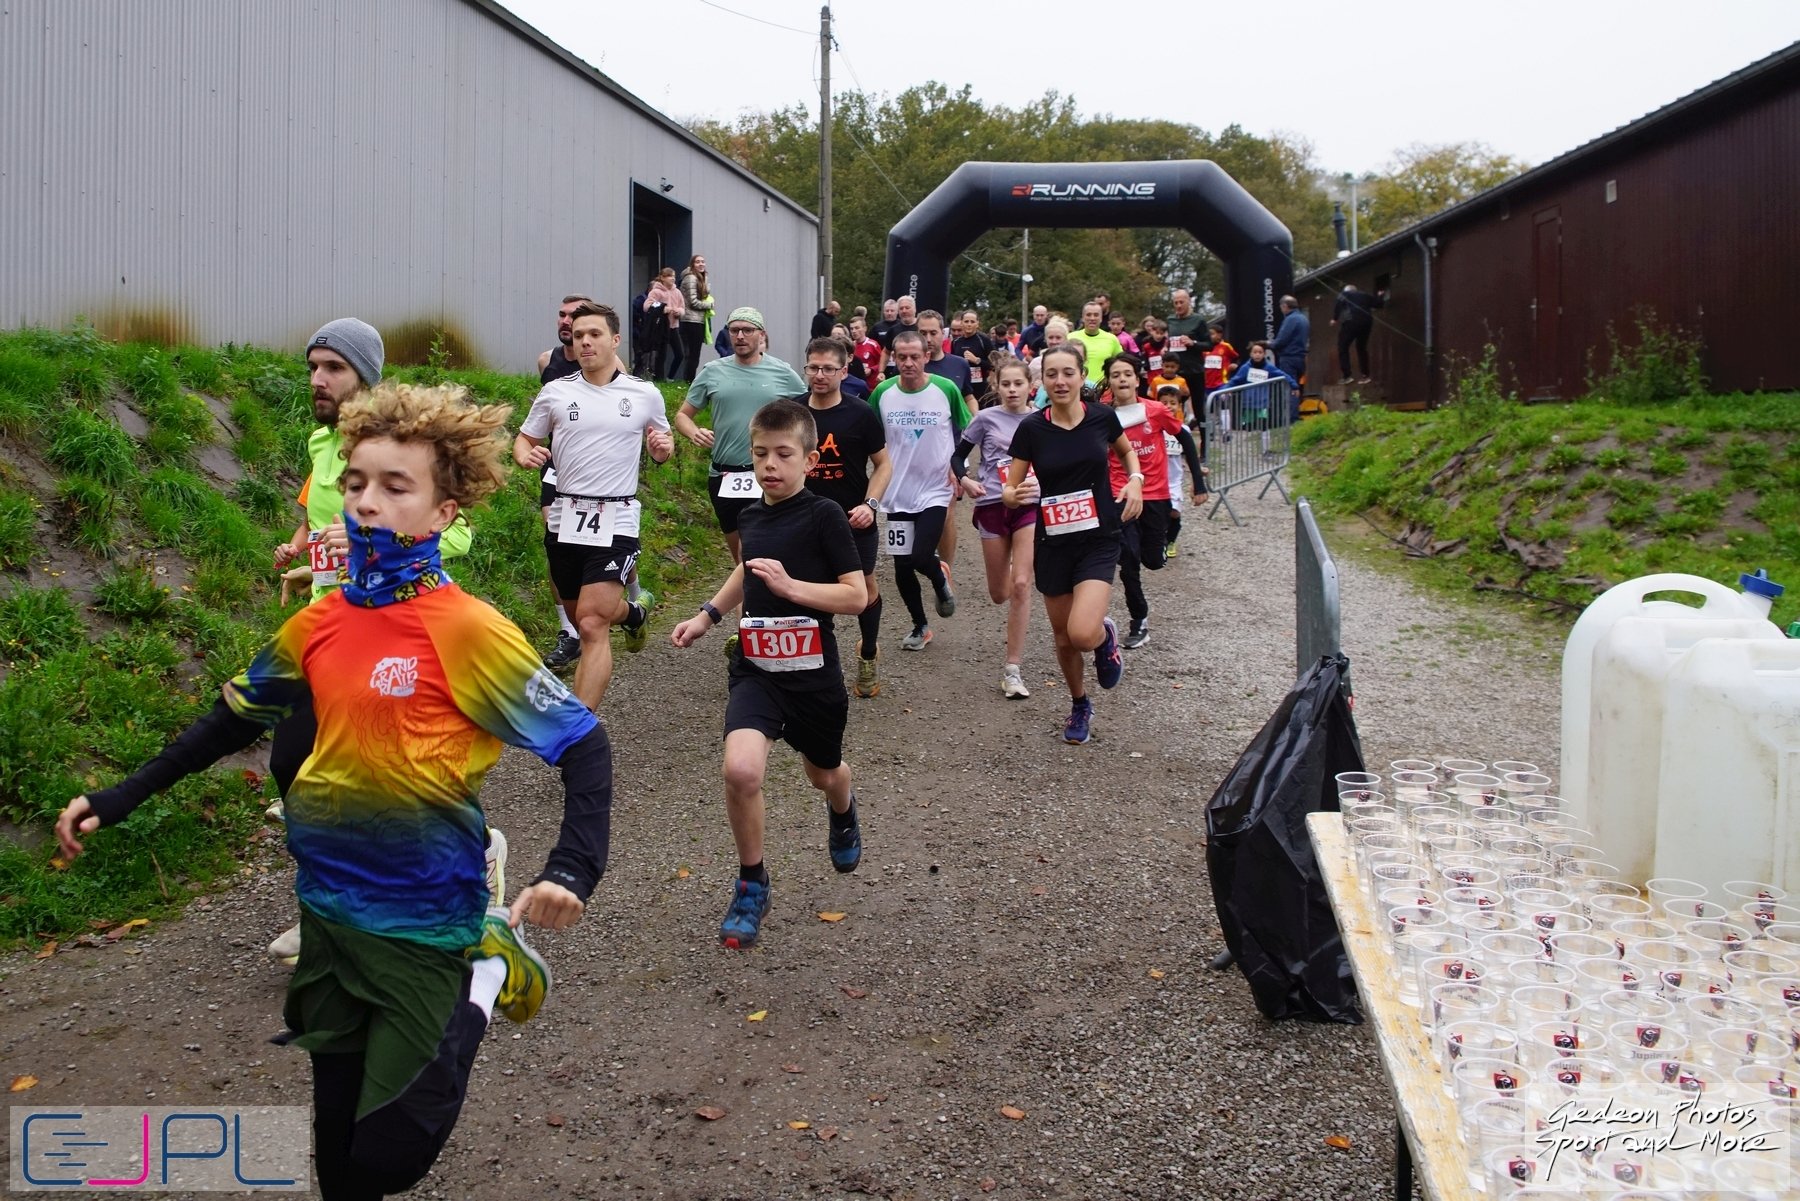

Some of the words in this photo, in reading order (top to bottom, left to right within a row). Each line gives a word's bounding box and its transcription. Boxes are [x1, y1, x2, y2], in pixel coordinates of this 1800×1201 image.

[1264, 278, 1274, 322] balance
[895, 418, 938, 426] VERVIERS
[732, 477, 754, 492] 33
[575, 511, 601, 534] 74
[1045, 500, 1093, 525] 1325
[888, 529, 906, 547] 95
[746, 630, 814, 657] 1307
